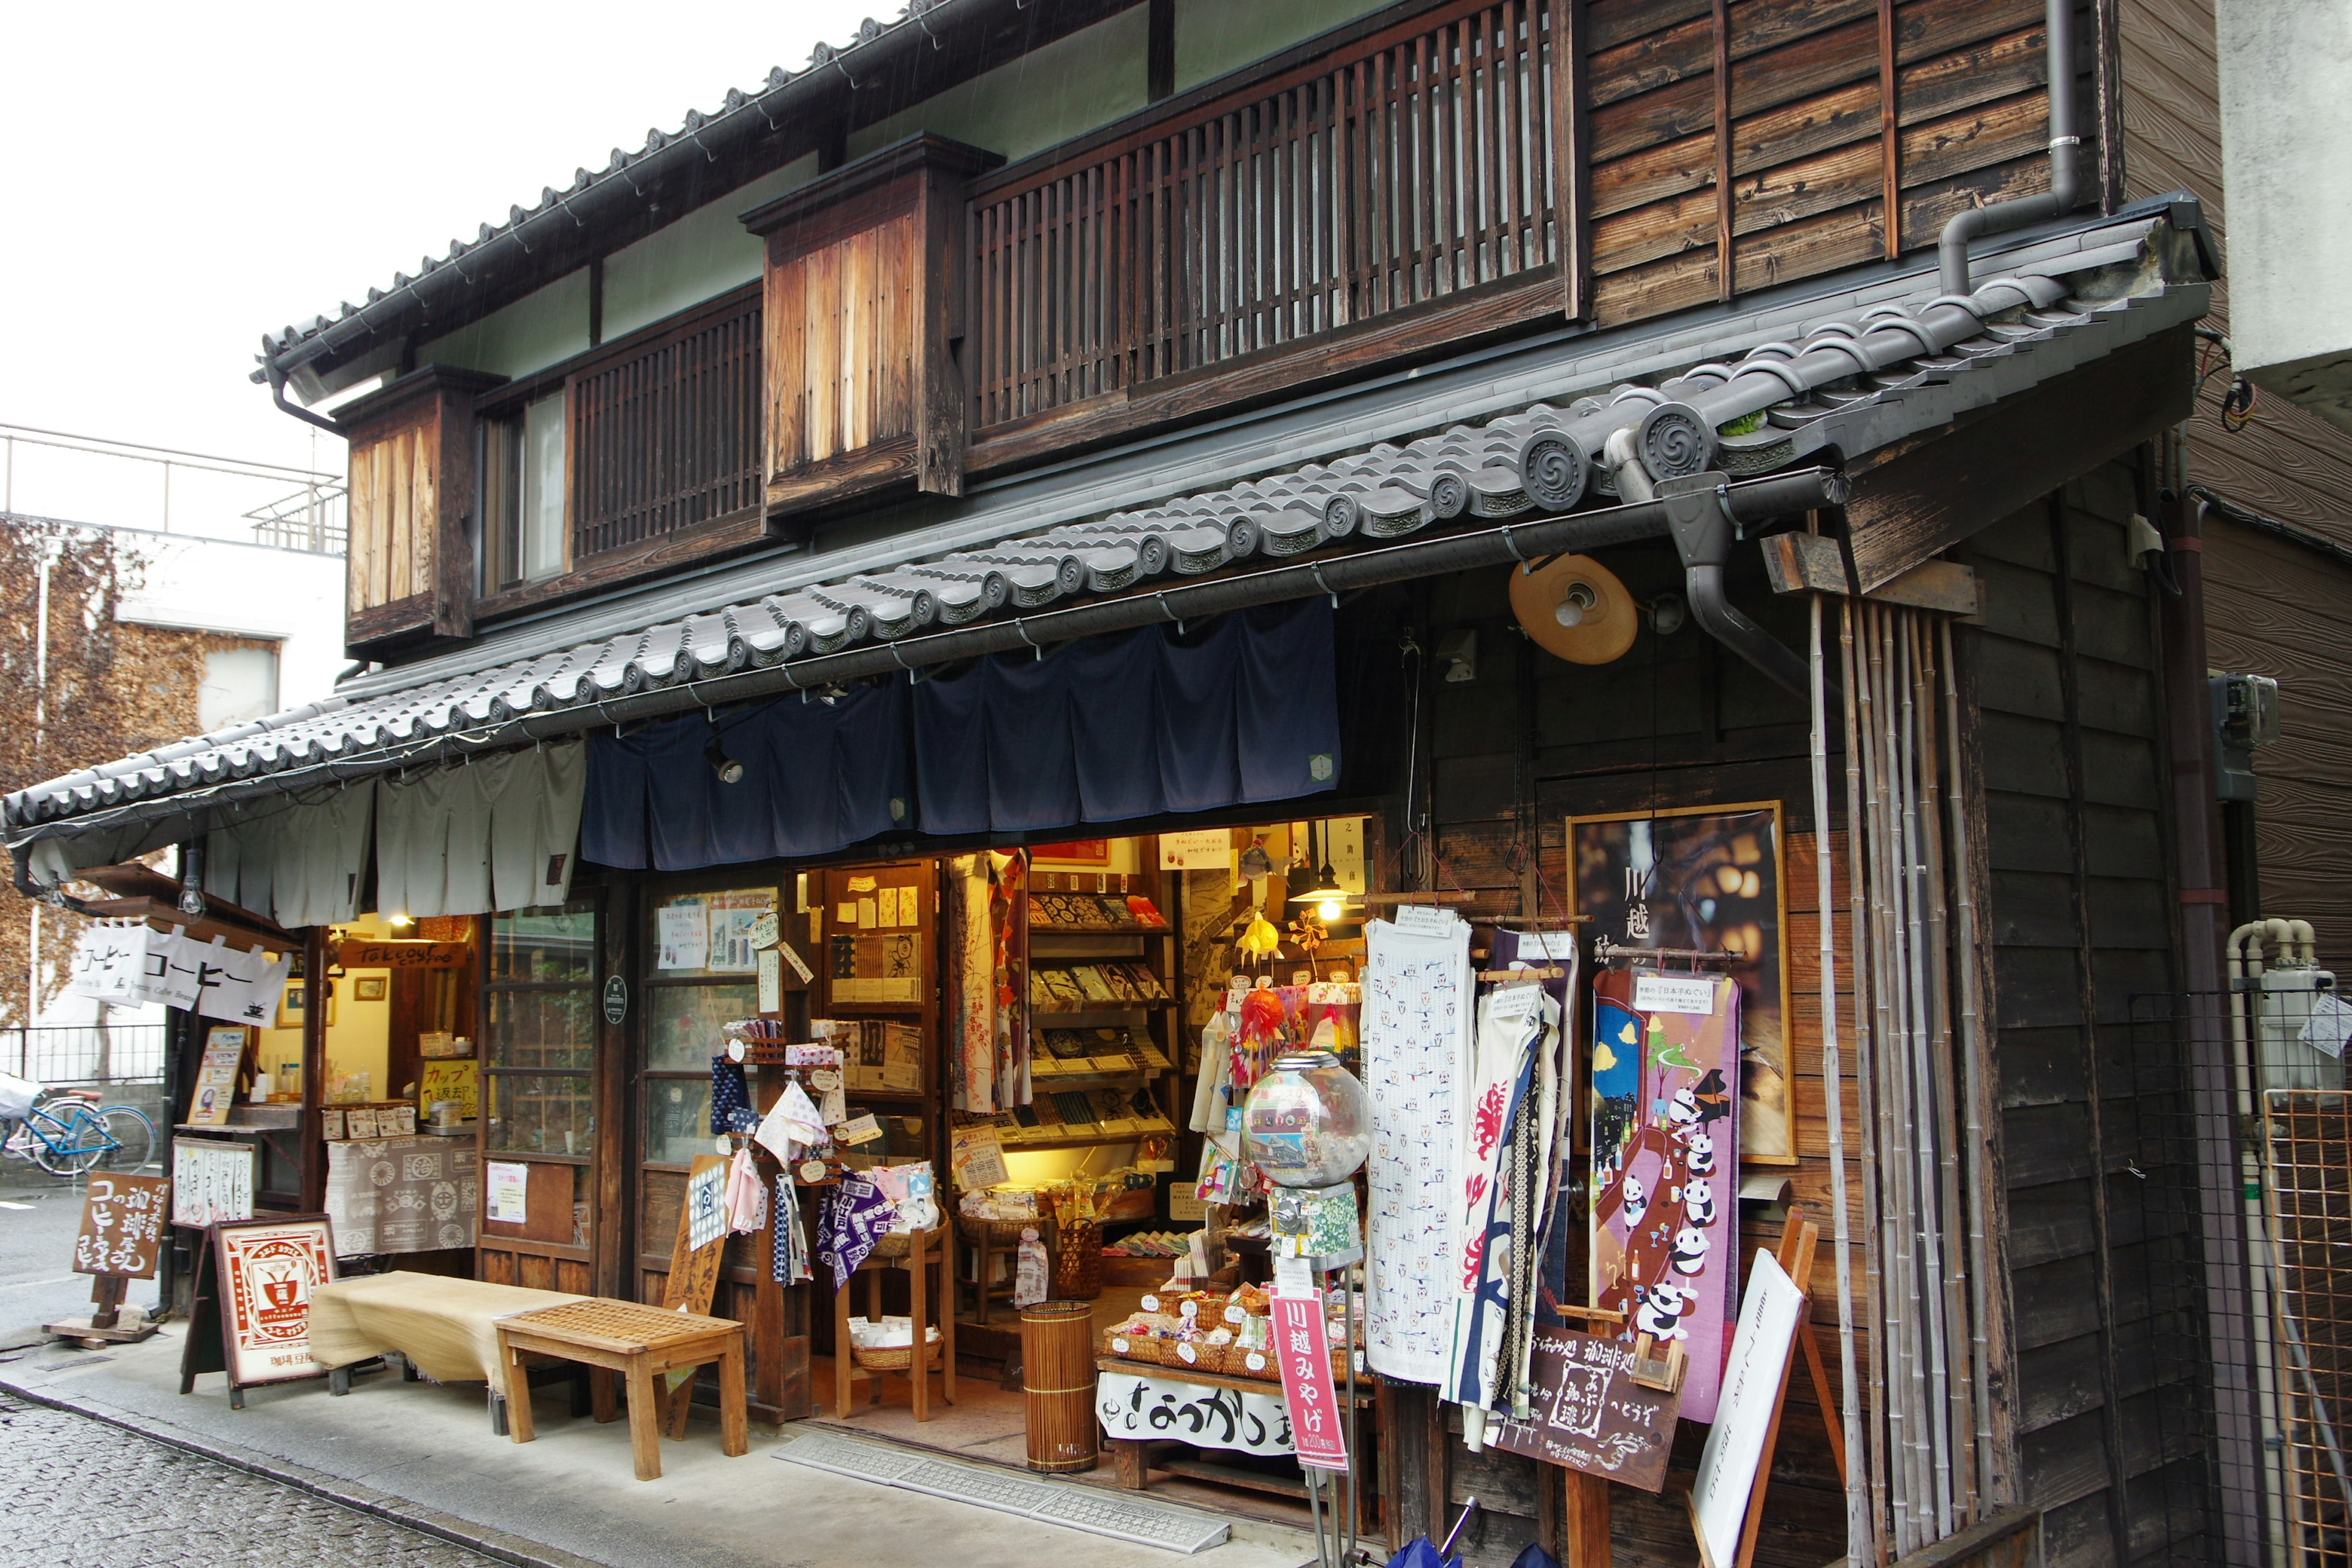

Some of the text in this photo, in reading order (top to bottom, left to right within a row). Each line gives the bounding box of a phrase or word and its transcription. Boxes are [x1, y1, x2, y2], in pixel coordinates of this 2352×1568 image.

[360, 944, 437, 963] Takeout
[398, 953, 453, 966] coffee
[145, 952, 253, 987] コーヒー
[1285, 1302, 1323, 1433] 川越みやげ
